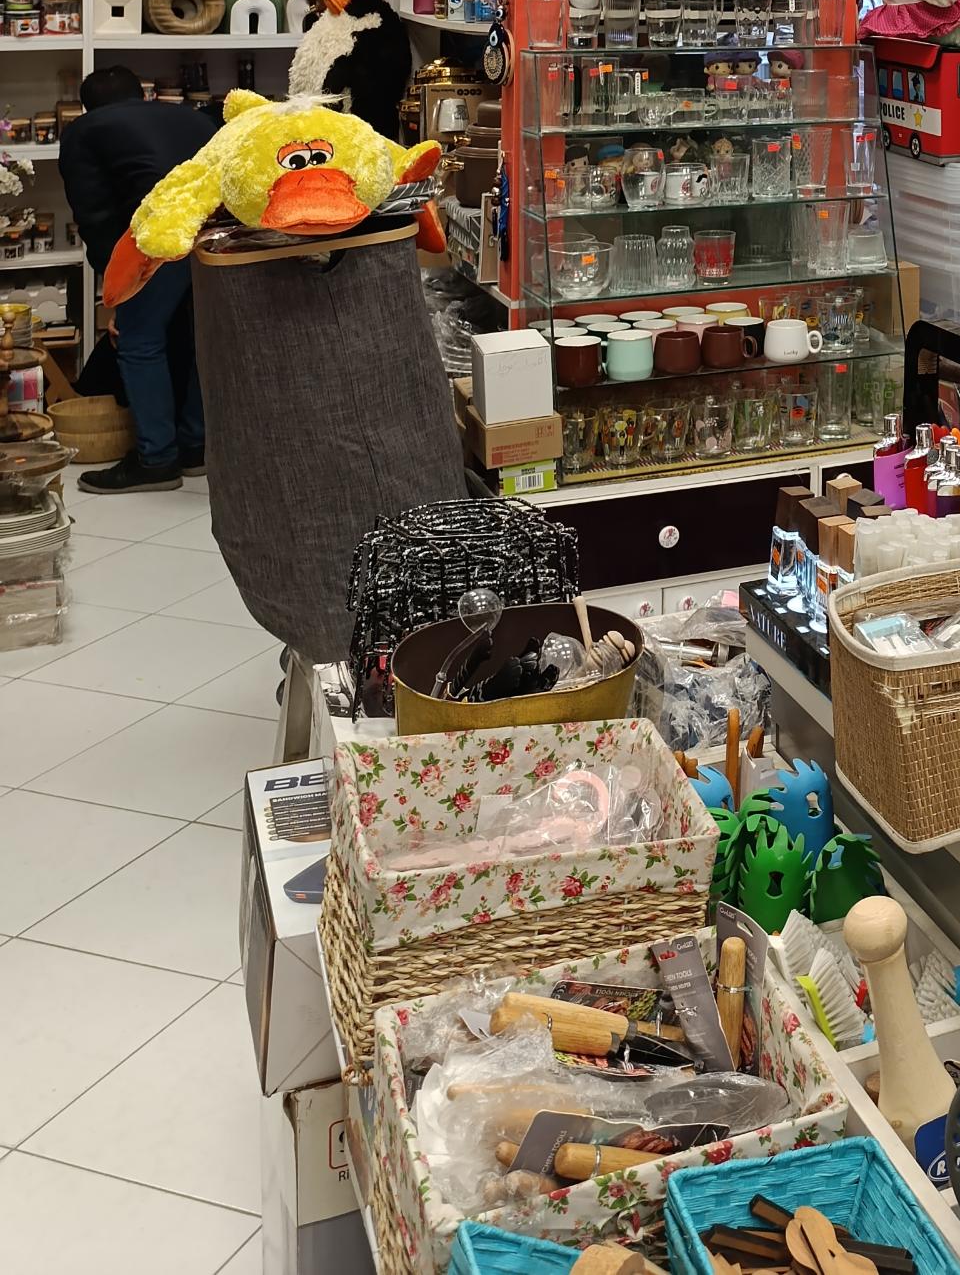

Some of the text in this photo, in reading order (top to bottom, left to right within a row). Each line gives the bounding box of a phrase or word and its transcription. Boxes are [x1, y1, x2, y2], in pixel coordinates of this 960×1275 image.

[272, 793, 313, 803] SANDWICH
[676, 969, 692, 979] TOOLS
[553, 1129, 568, 1150] TOOLS
